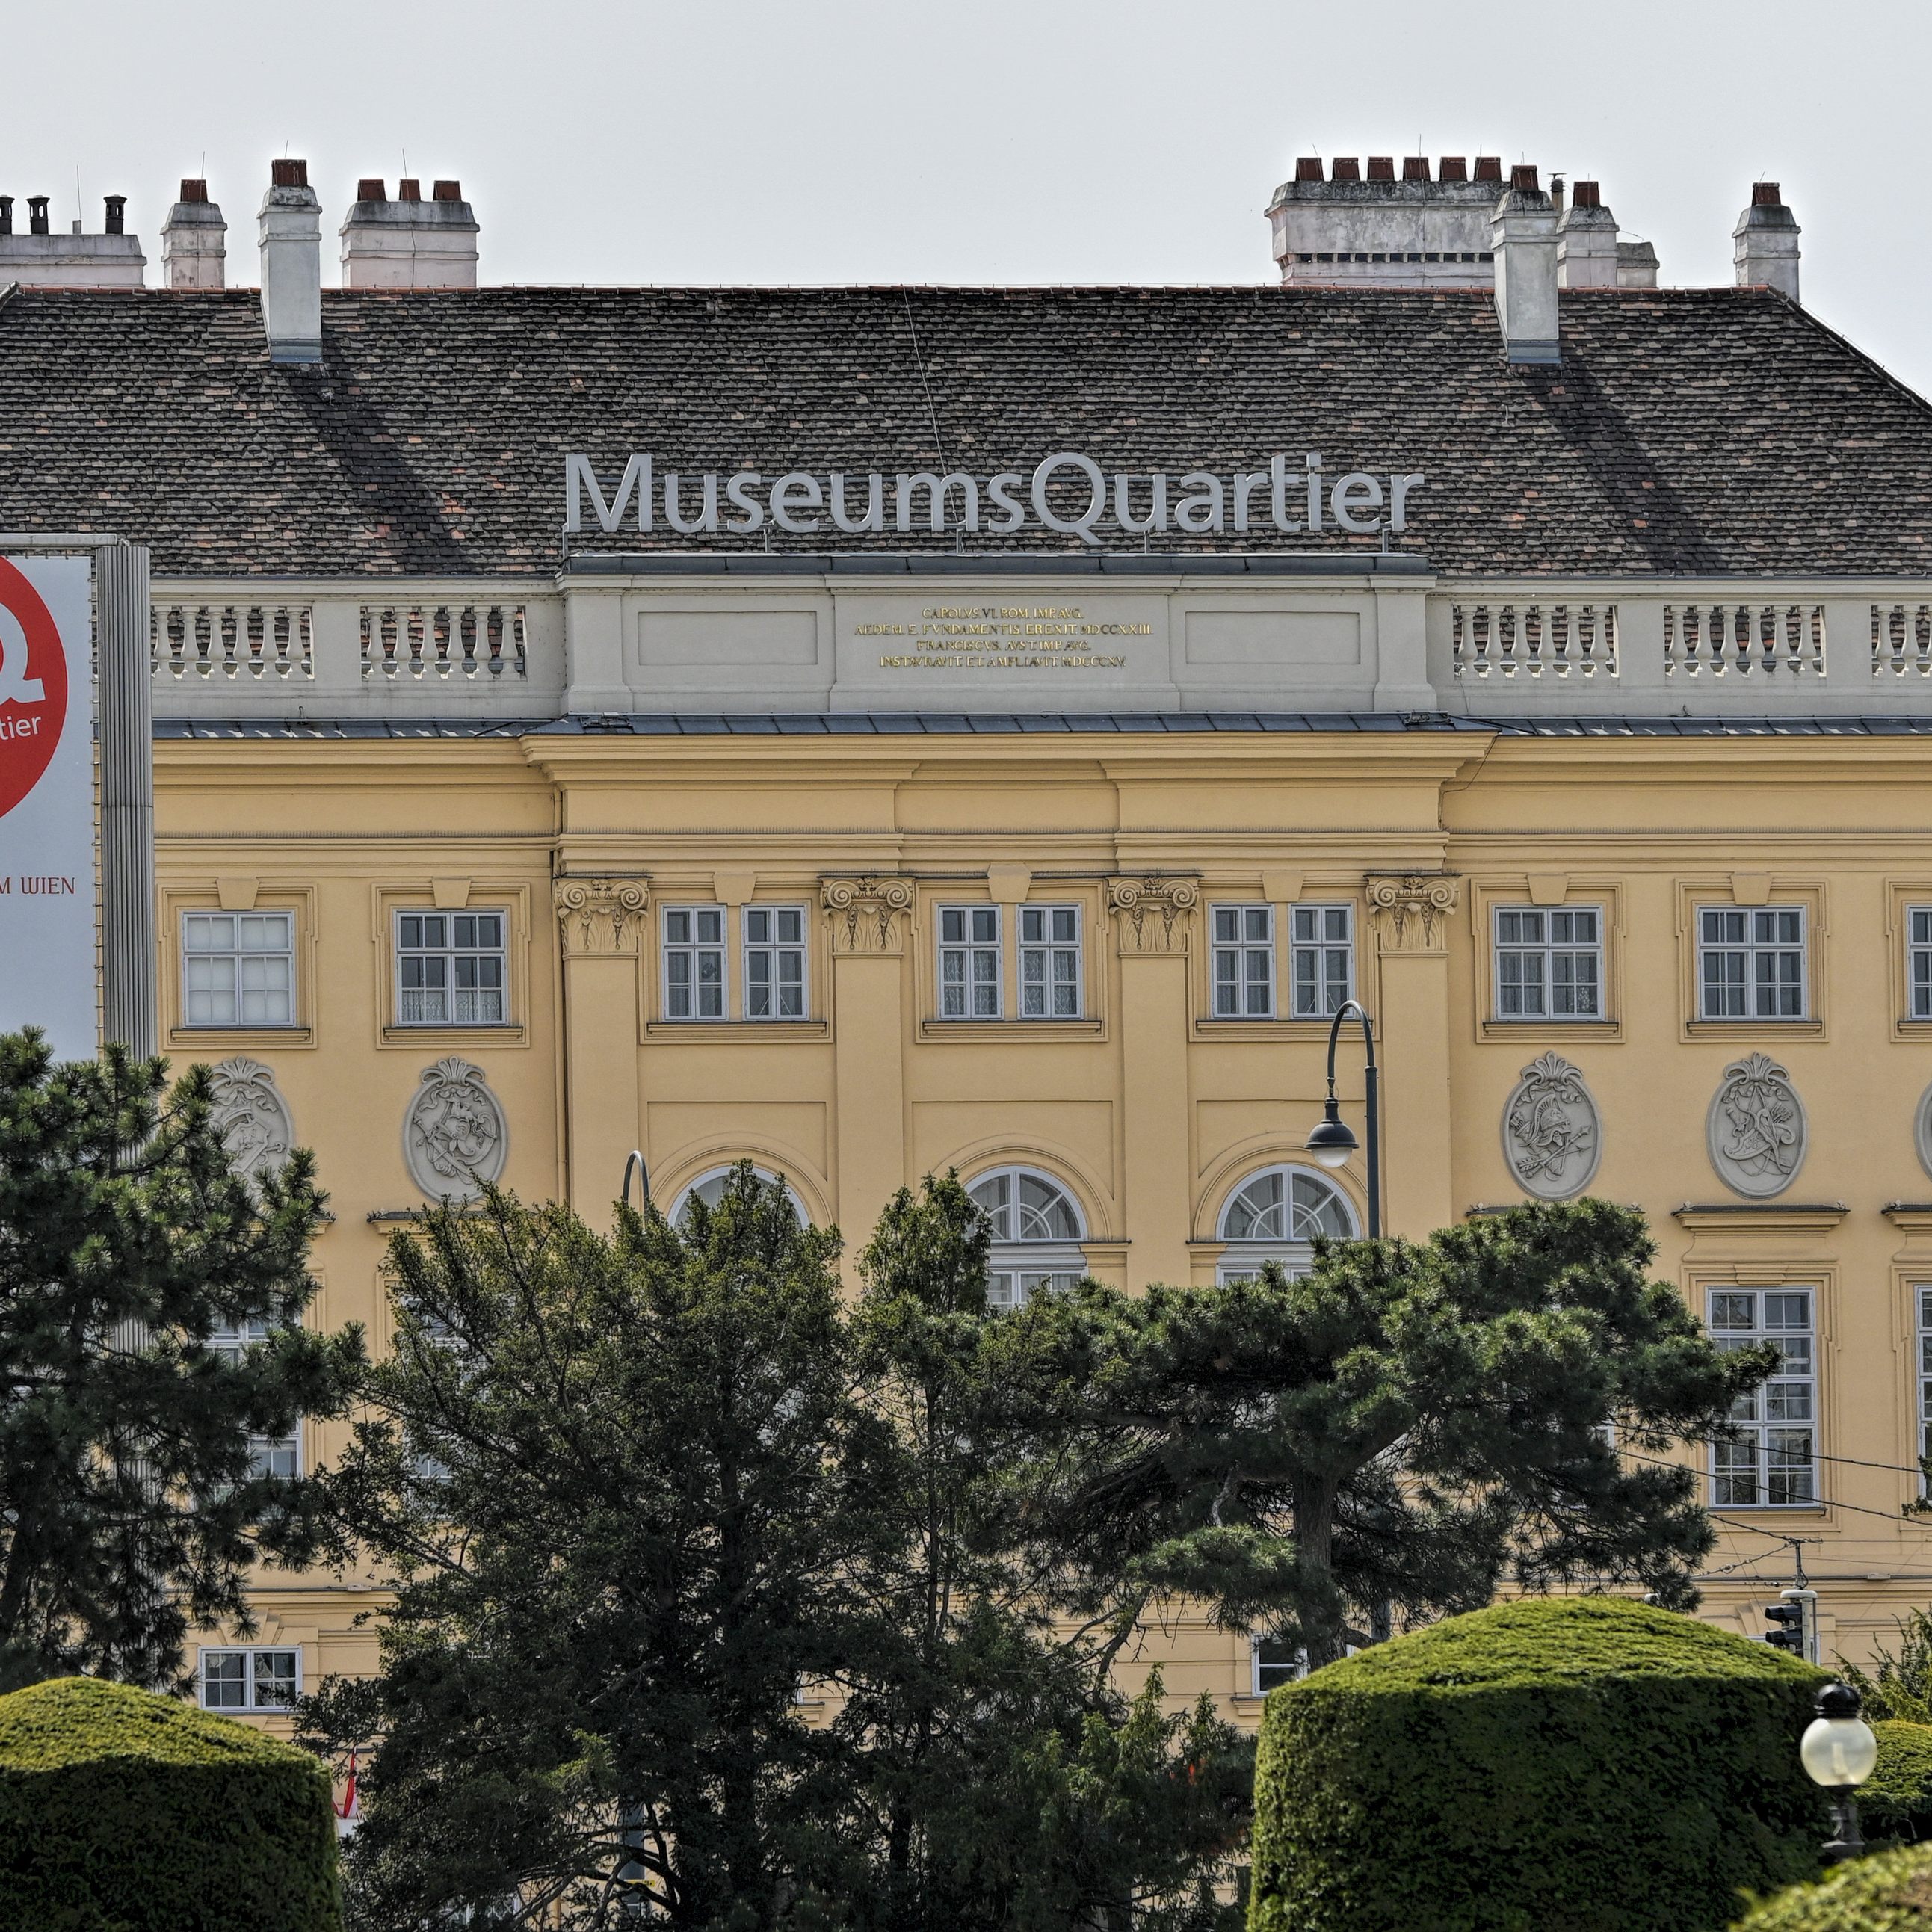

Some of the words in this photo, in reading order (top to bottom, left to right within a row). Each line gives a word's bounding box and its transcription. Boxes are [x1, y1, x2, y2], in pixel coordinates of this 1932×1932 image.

[565, 451, 1425, 546] MuseumsQuartier
[1000, 608, 1031, 619] ROM.
[1025, 624, 1078, 635] EREXIT.
[1080, 624, 1153, 635] MDCCXXIII.
[916, 641, 1001, 652] FRANCISCVS.
[20, 877, 75, 895] WIEN
